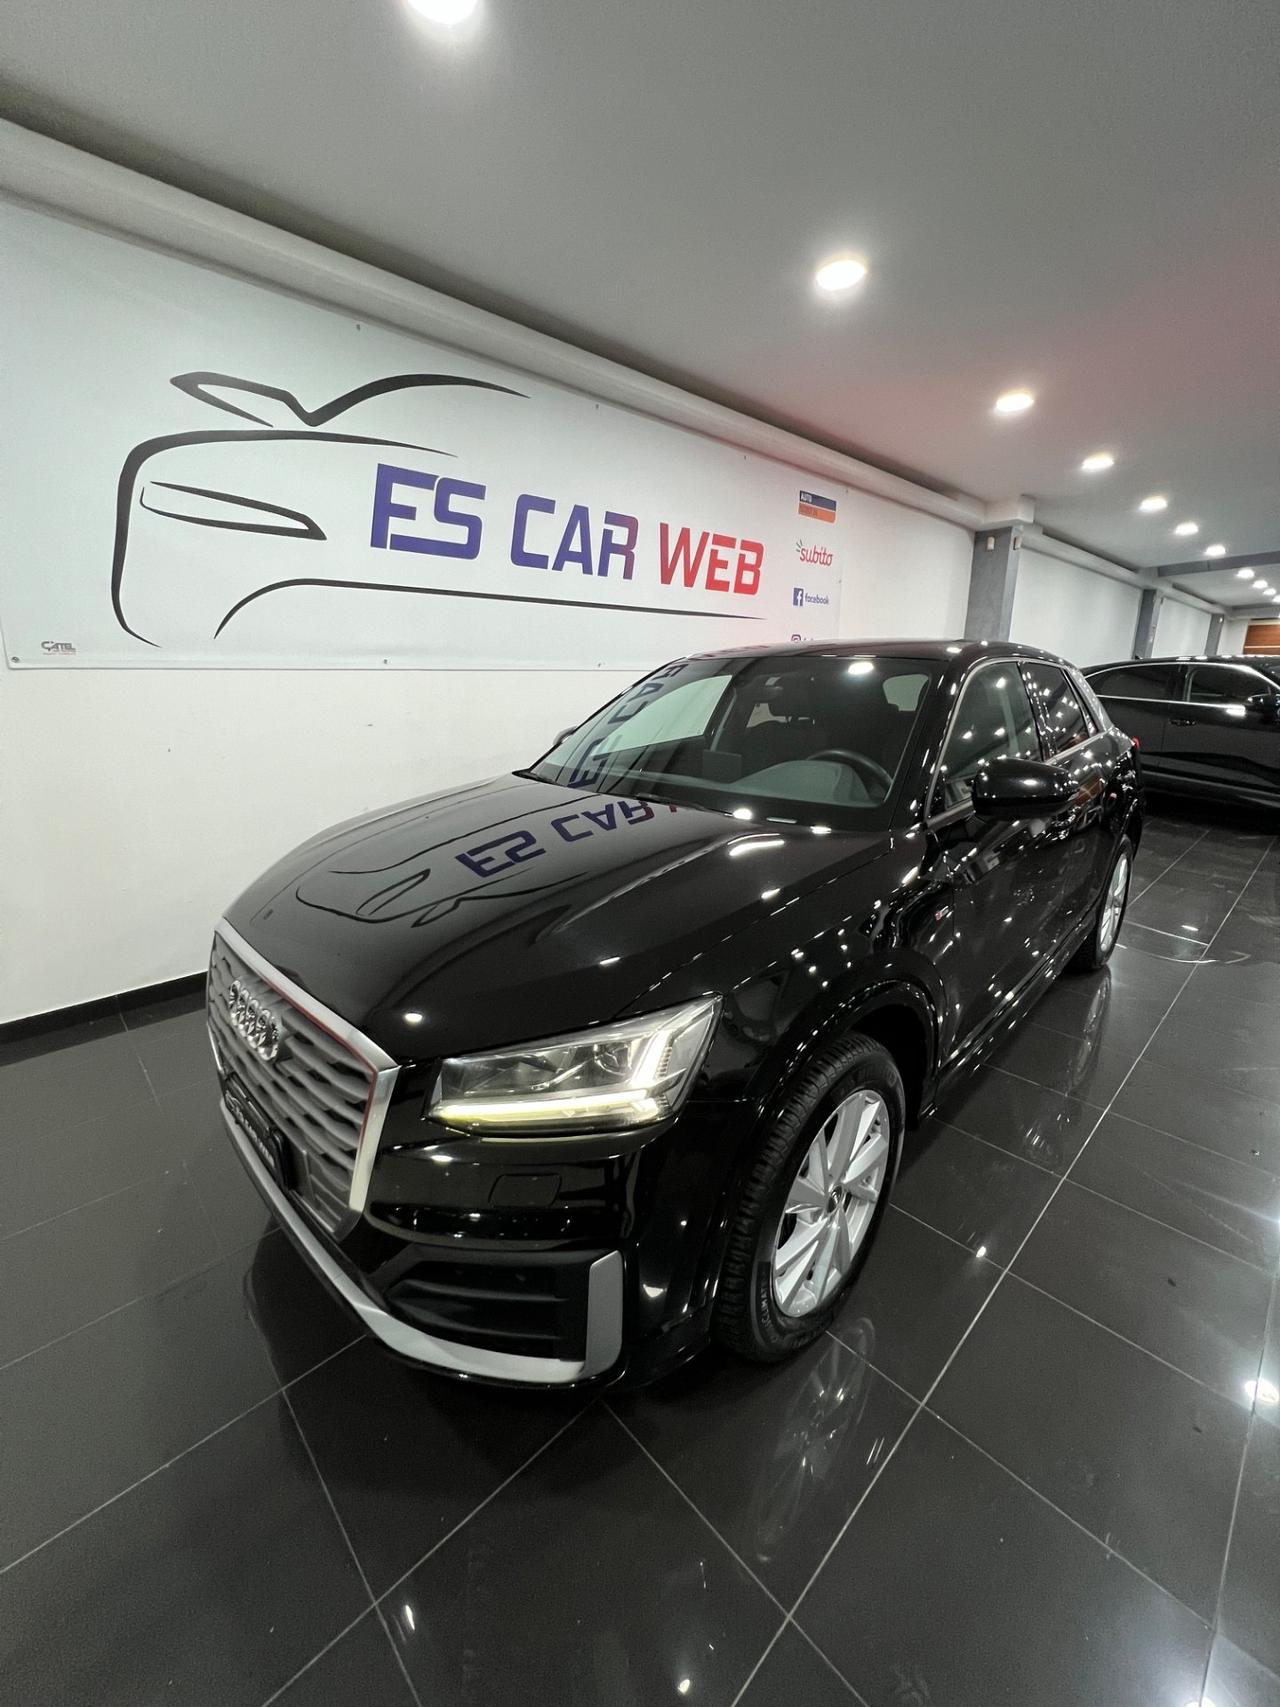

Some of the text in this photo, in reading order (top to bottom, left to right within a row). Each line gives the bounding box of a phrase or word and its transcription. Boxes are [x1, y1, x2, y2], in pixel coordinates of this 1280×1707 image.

[369, 463, 766, 597] ES CAR WEB
[799, 545, 834, 567] subito
[805, 593, 829, 604] facebook
